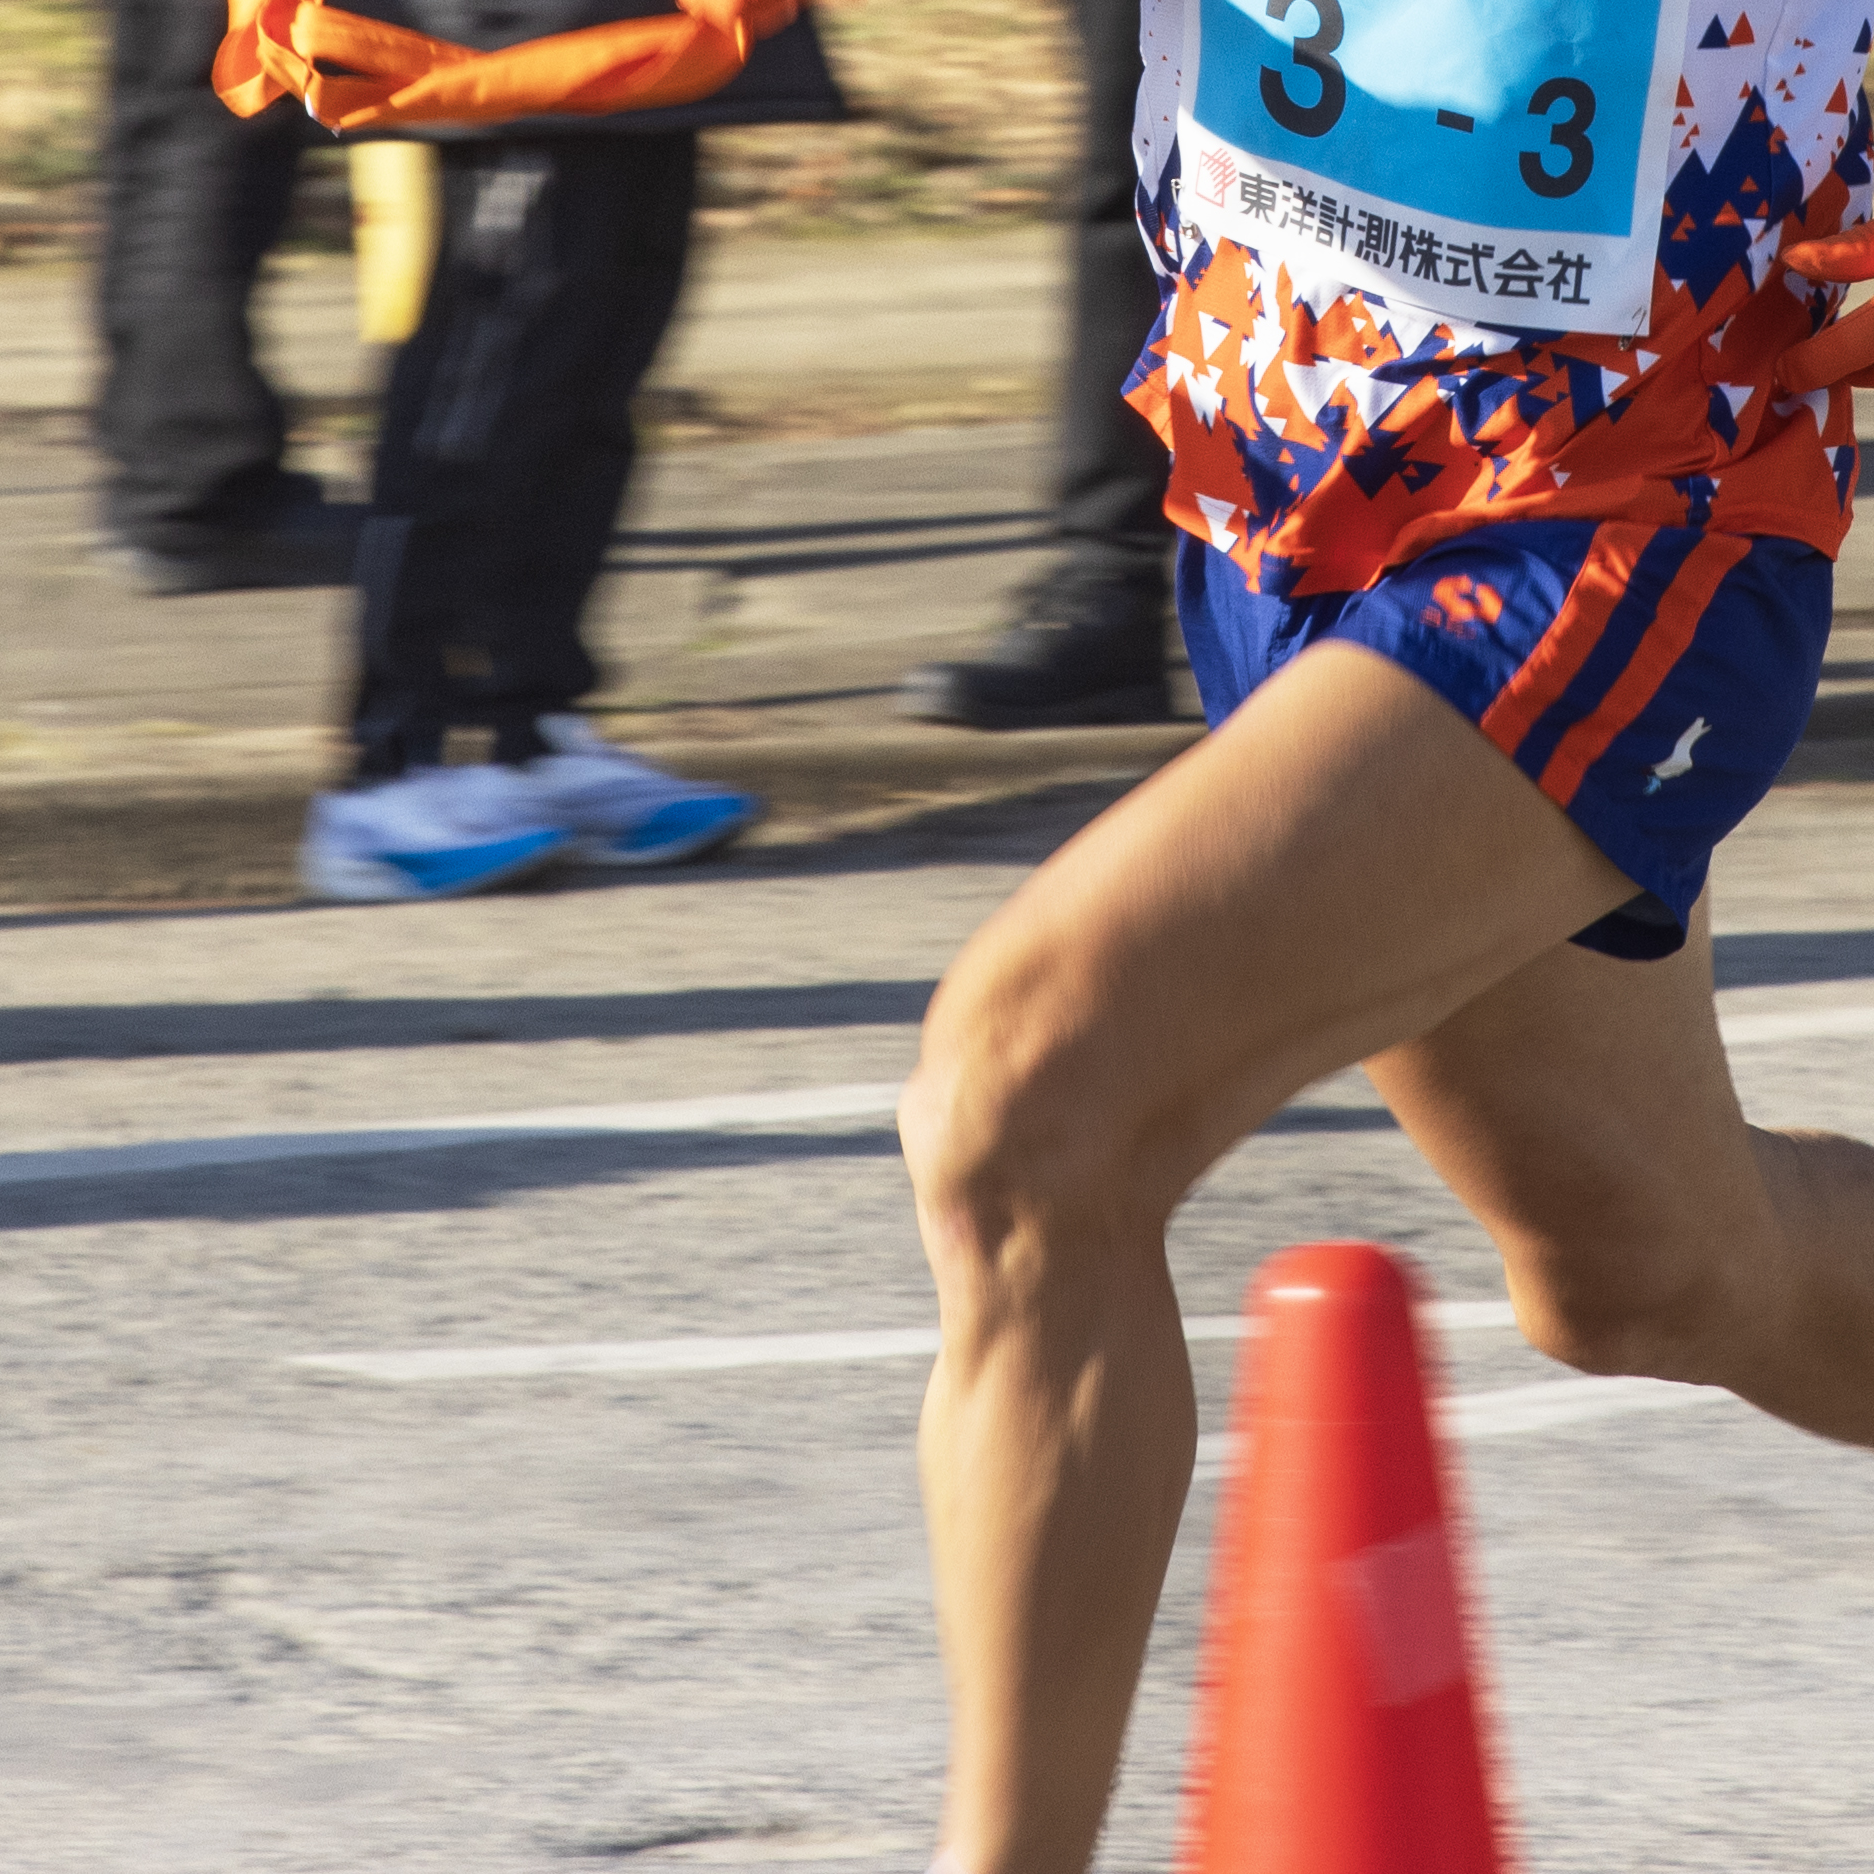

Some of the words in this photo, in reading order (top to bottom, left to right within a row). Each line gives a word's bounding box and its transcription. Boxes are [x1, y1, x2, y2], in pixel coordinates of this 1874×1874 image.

[1238, 171, 1592, 306] 東洋計測株式会社
